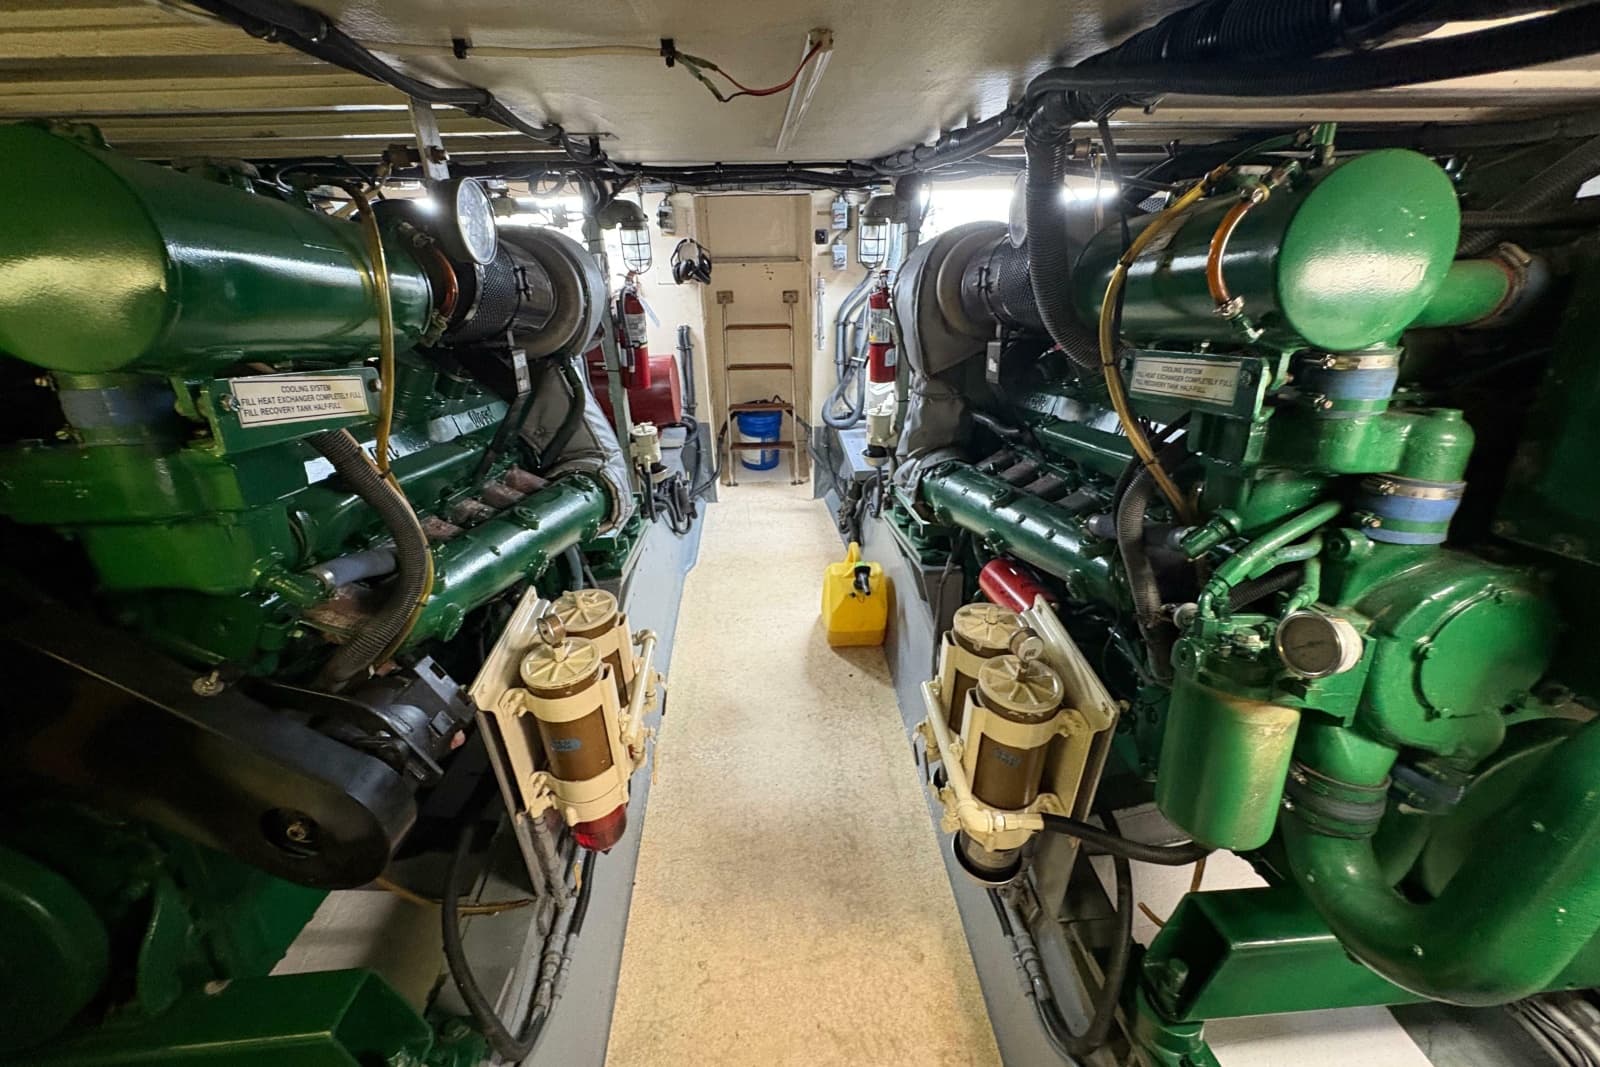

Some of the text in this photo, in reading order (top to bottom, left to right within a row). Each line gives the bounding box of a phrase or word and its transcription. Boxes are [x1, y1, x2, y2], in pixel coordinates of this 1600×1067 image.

[281, 384, 332, 393] COOLING SYSTEM
[241, 391, 362, 406] FILL HEAT EXCHANGER COMPLETELY FULL
[243, 408, 258, 417] FILL
[260, 405, 295, 416] RECOVERY
[296, 404, 313, 413] TANK
